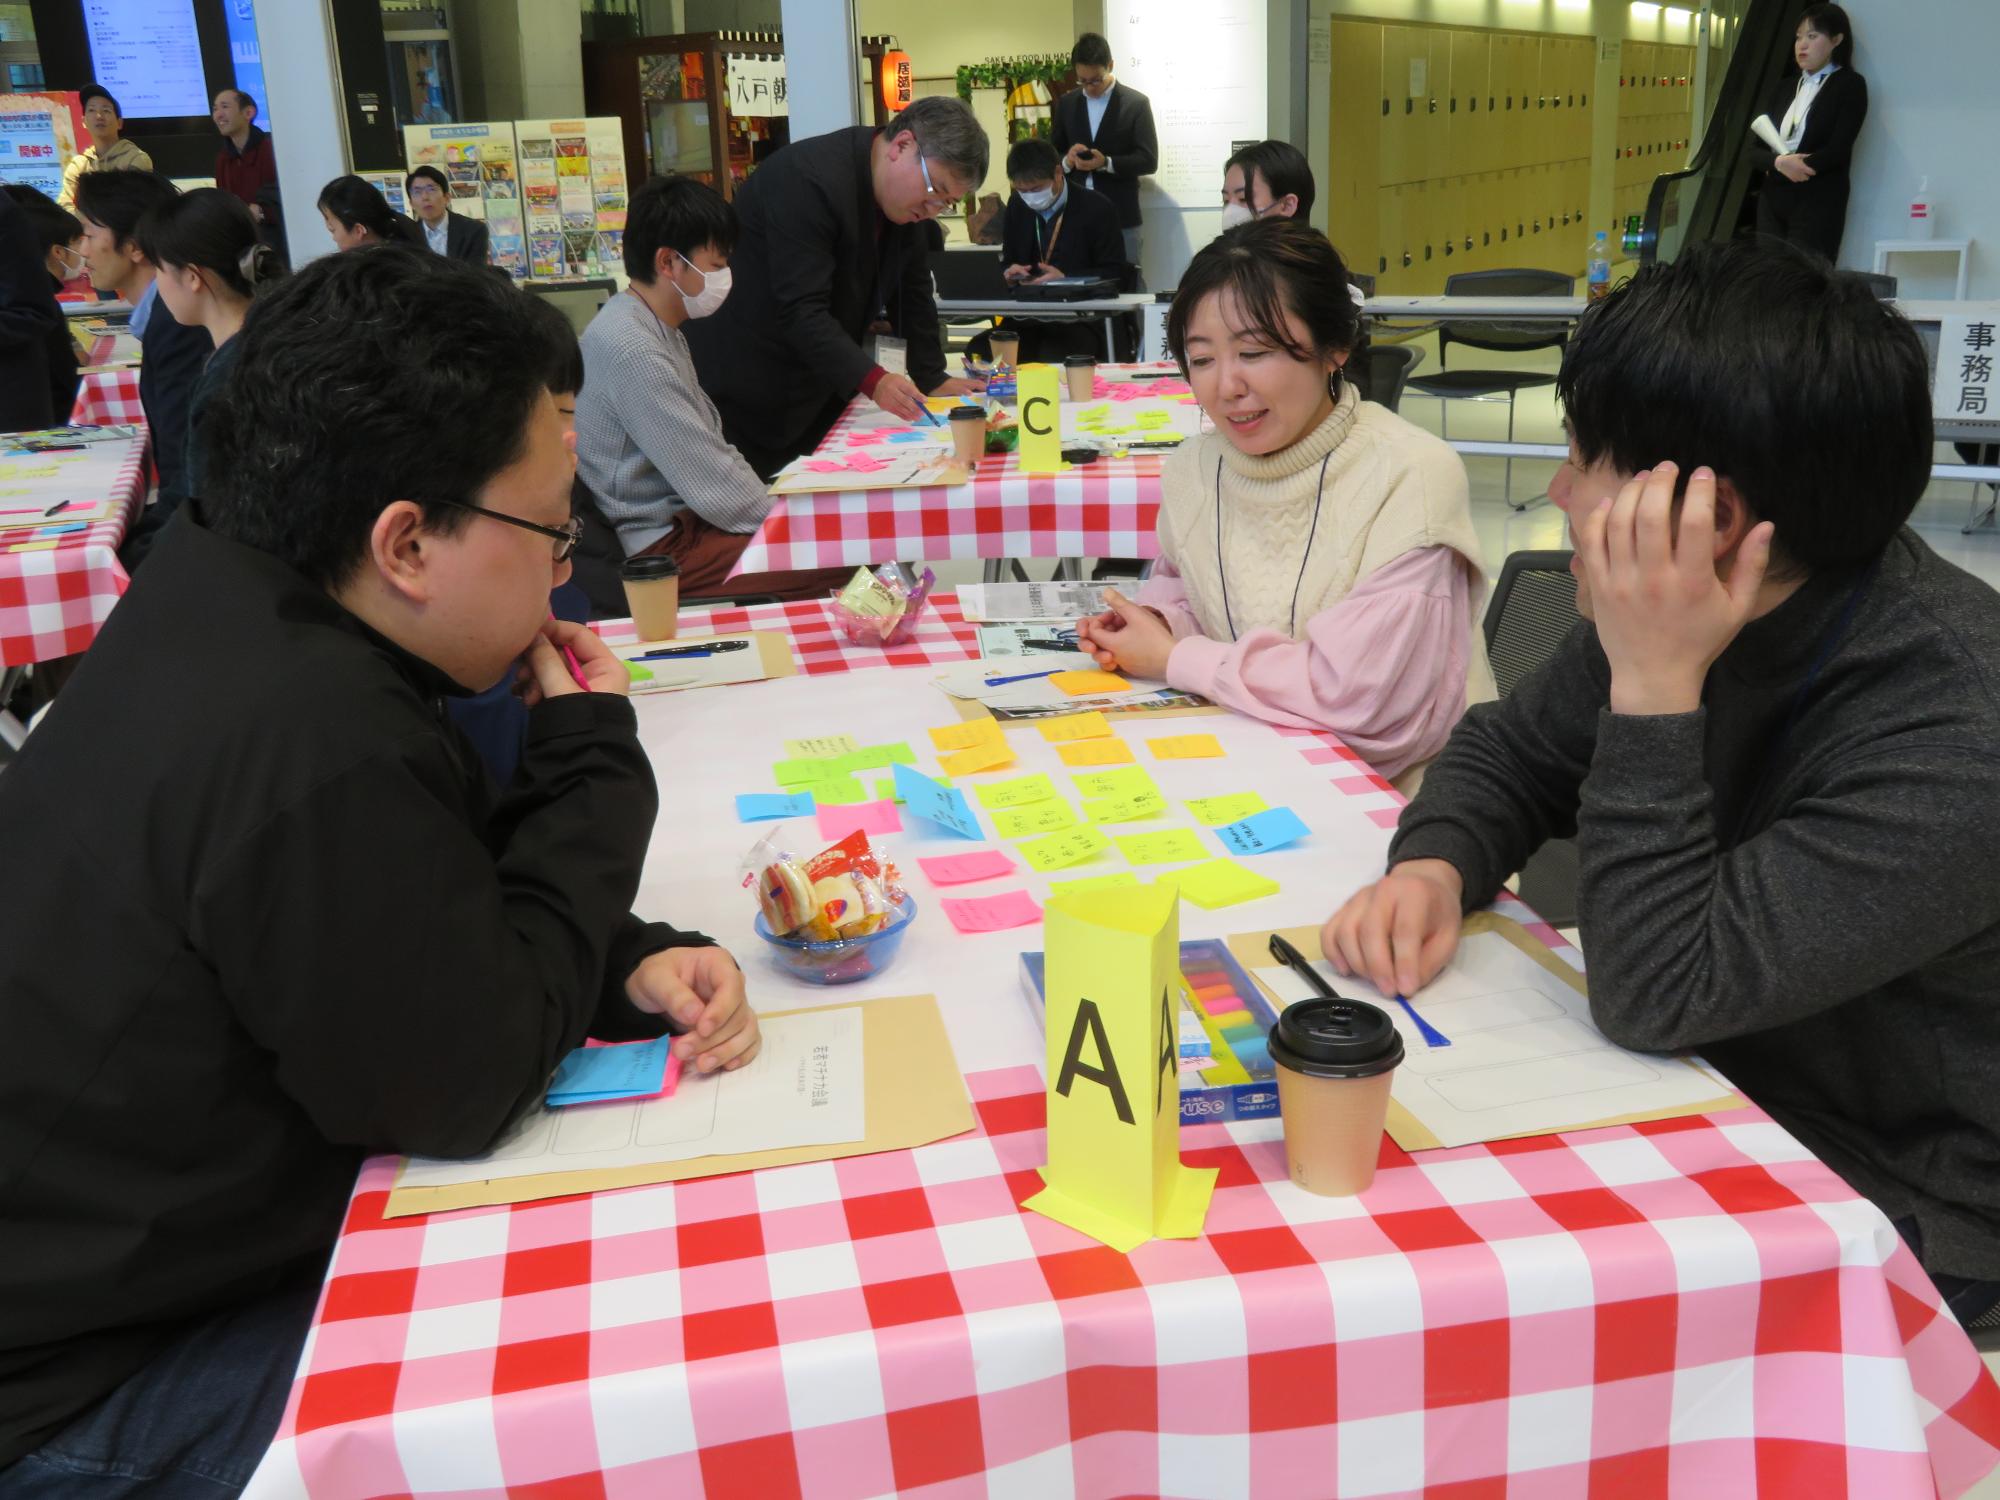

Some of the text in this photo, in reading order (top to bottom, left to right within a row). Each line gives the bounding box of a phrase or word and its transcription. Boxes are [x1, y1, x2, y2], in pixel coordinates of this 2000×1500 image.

[1016, 53, 1040, 62] FOOD
[1042, 53, 1051, 61] IN
[897, 62, 911, 101] 居酒屋
[19, 145, 53, 157] 開催中
[1957, 321, 1996, 414] 事務局
[1023, 397, 1052, 435] C
[1055, 998, 1136, 1126] A
[1156, 983, 1177, 1119] A
[1179, 1100, 1225, 1116] use
